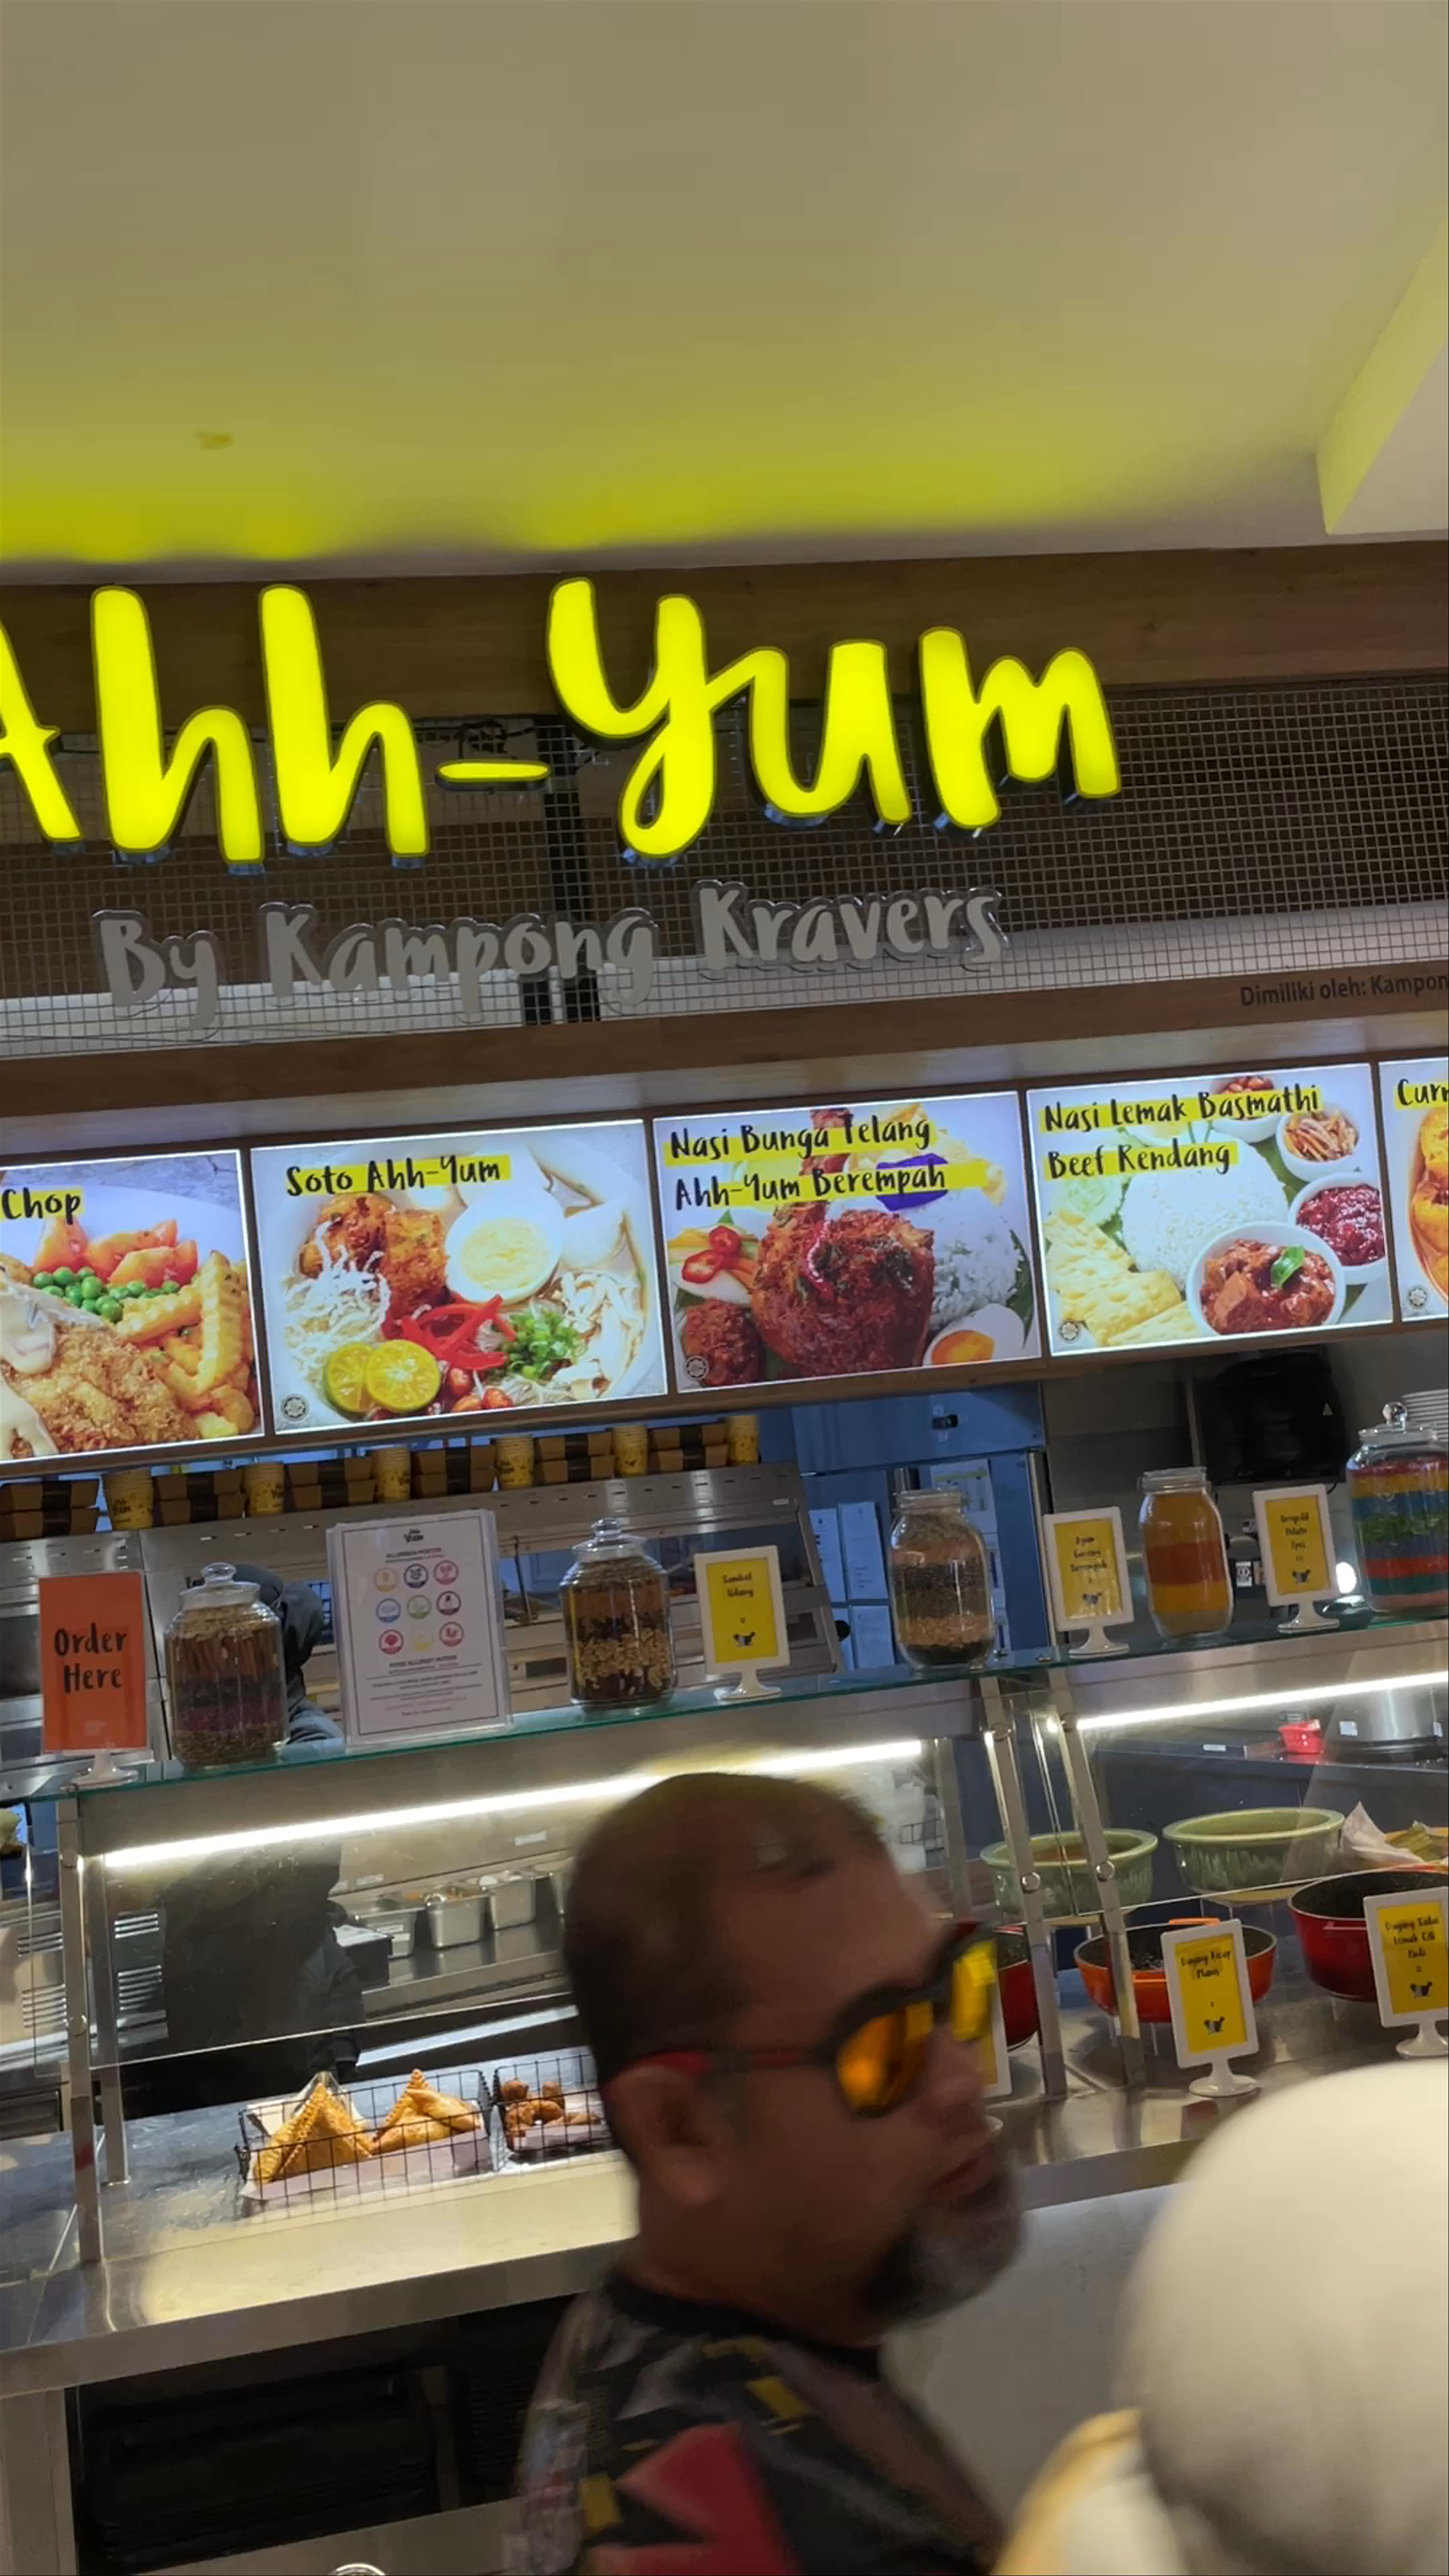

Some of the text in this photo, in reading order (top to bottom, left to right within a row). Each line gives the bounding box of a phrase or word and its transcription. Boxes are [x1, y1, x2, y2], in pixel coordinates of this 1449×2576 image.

[93, 880, 1003, 1032] By Kampong Kravers
[1240, 974, 1449, 1006] Dimiliki oleh: Kampon
[1045, 1083, 1318, 1132] Nasi Lemak Basmathi
[671, 1114, 931, 1160] Nasi Bunga Telang
[286, 1155, 500, 1196] Soto Ahh-Yum
[1048, 1137, 1231, 1179] Beef Rendang
[675, 1154, 946, 1210] Ahh-Yum Berempah
[2, 1187, 80, 1225] Chop
[54, 1622, 128, 1656] Order
[63, 1665, 122, 1693] Here
